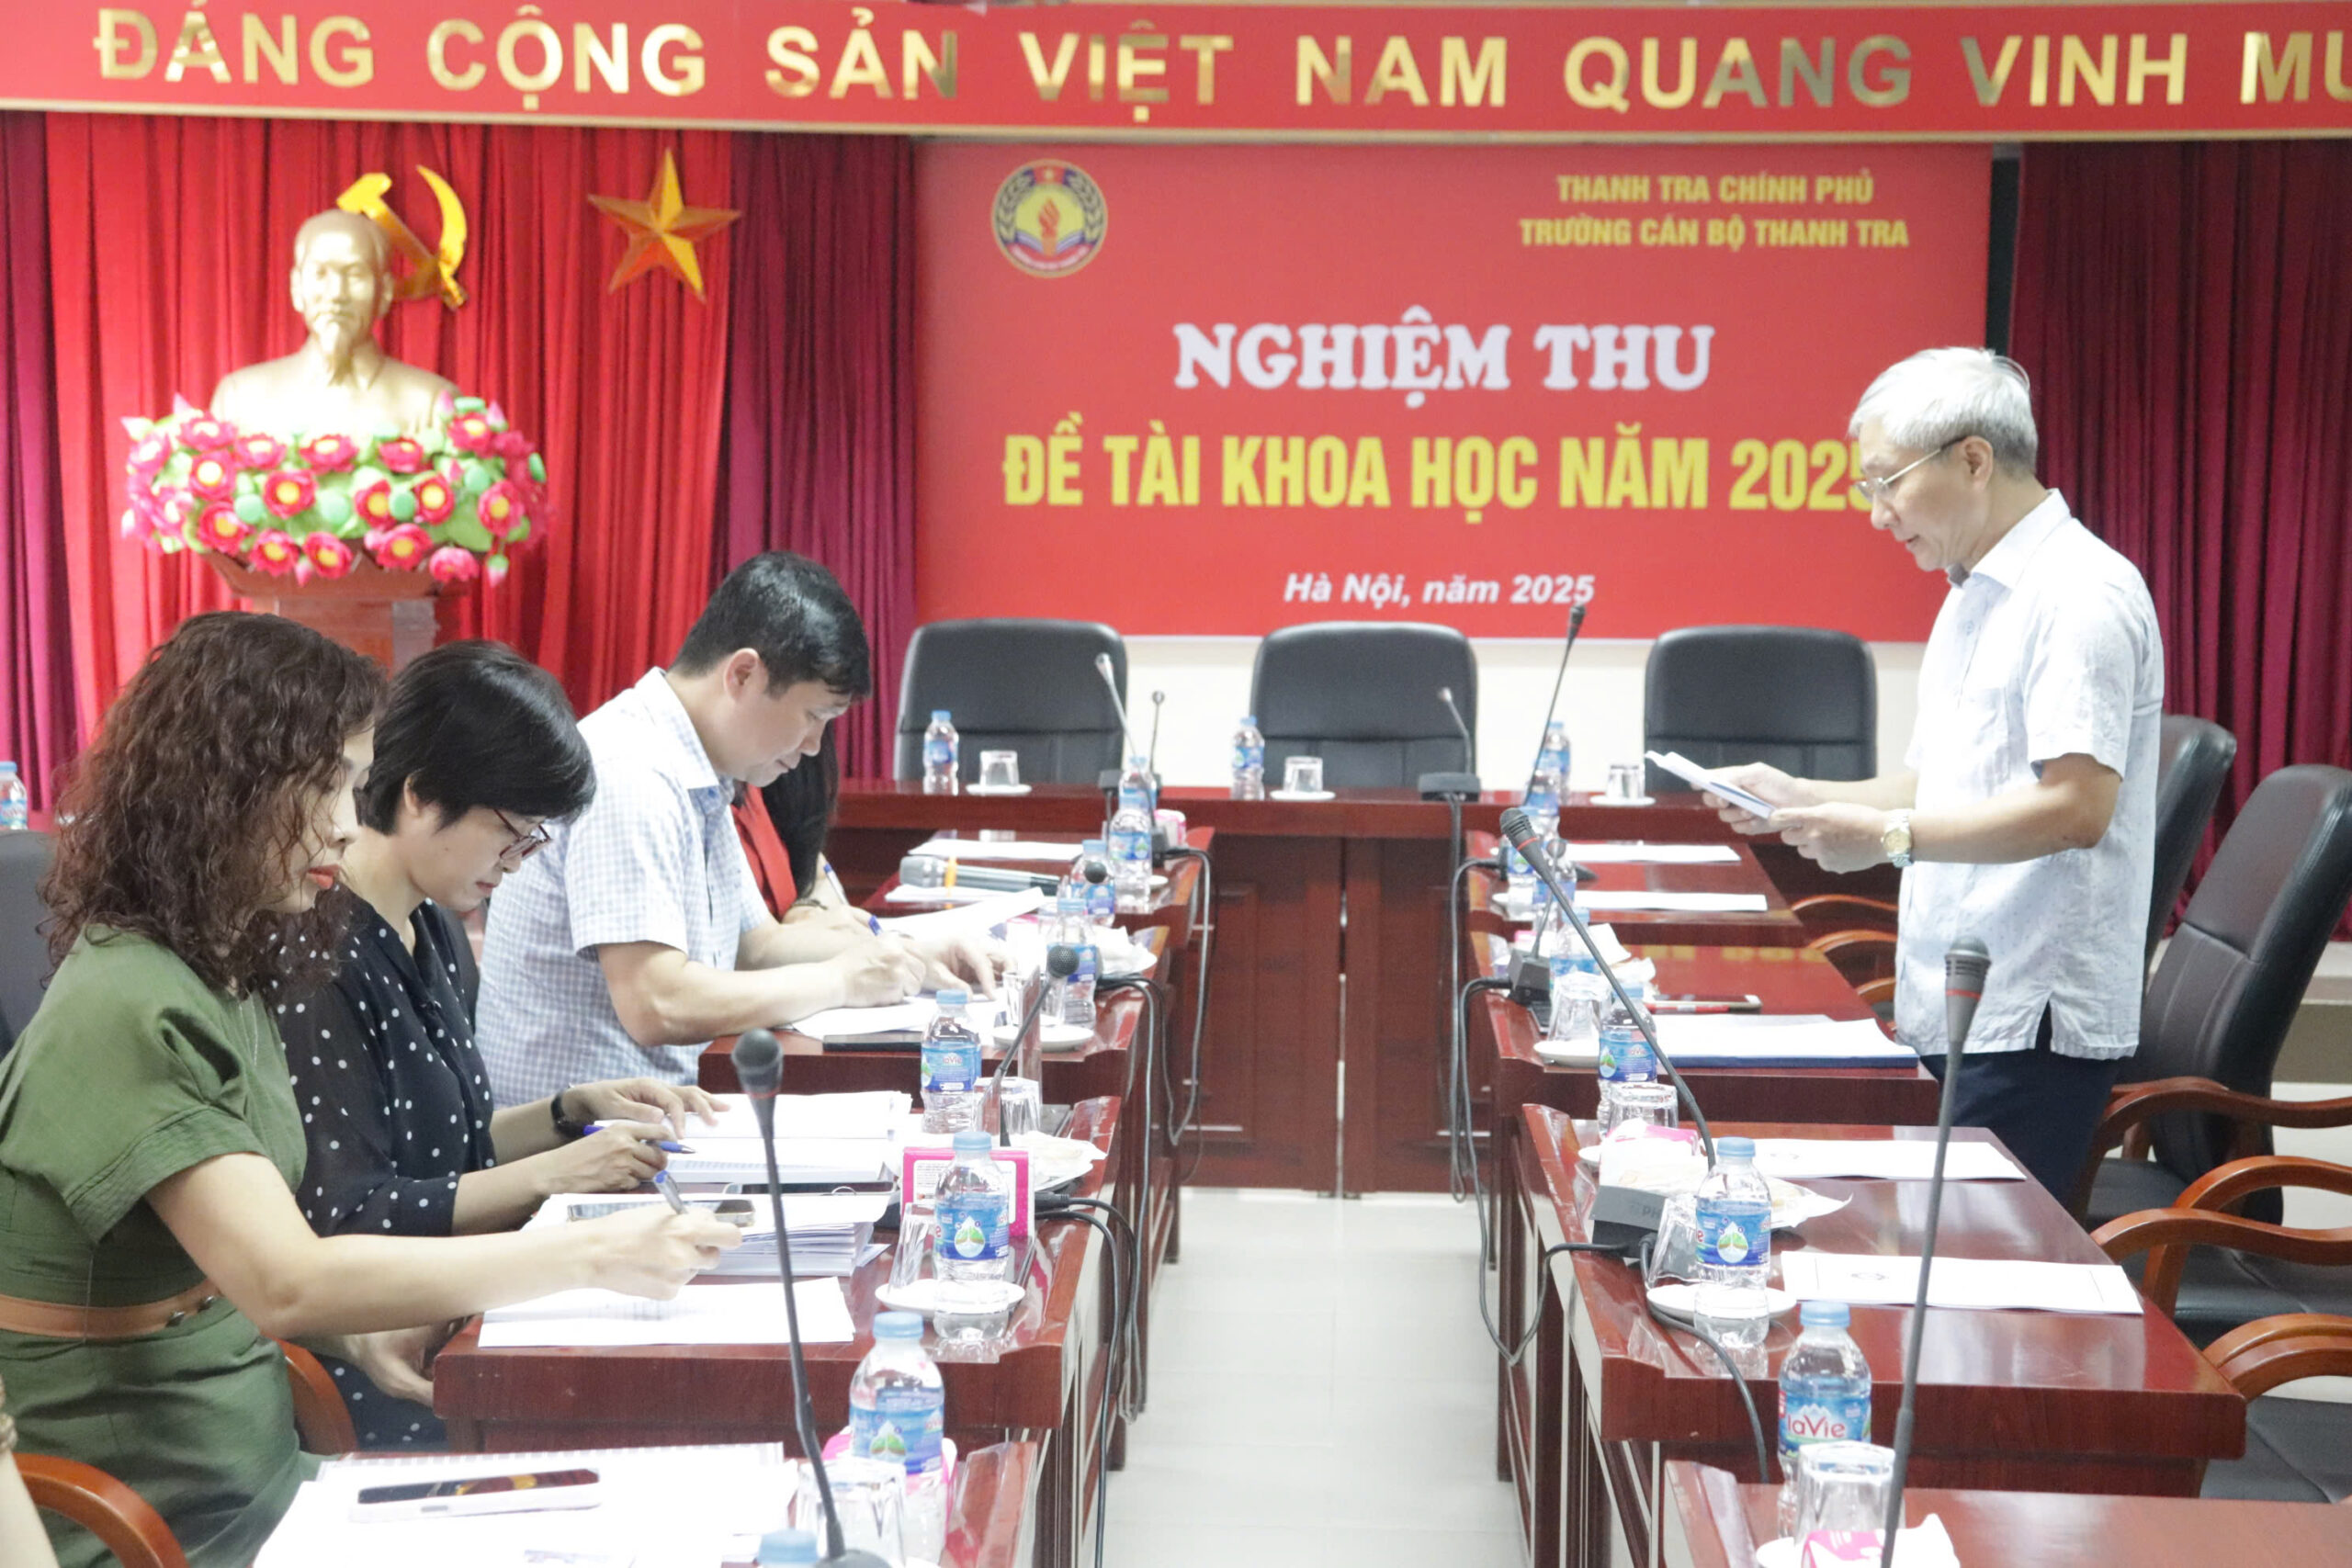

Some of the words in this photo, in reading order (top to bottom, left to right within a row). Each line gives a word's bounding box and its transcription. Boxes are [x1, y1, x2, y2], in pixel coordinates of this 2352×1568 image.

[425, 6, 705, 110] CỘNG
[765, 7, 958, 99] SẢN
[1019, 20, 1233, 122] VIỆT
[1297, 36, 1506, 107] NAM
[1563, 37, 1911, 113] QUANG
[1964, 34, 2187, 106] VINH
[1558, 175, 1649, 201] THANH
[1659, 175, 1710, 202] TRA
[1718, 171, 1807, 203] CHÍNH
[1815, 168, 1874, 203] PHỦ
[1520, 213, 1632, 246] TRƯỜNG
[1707, 215, 1745, 251] BỘ
[1755, 220, 1848, 246] THANH
[1856, 220, 1908, 246] TRA
[1173, 306, 1510, 408] NGHIỆM
[1534, 325, 1714, 390] THU
[1002, 412, 1082, 505] ĐỀ
[1103, 421, 1200, 505] TÀI
[1223, 436, 1390, 507] KHOA
[1411, 436, 1537, 524] HỌC
[1560, 423, 1708, 508] NĂM
[1284, 573, 1331, 602] Hà
[1342, 573, 1409, 609] Nội,
[1423, 575, 1499, 603] năm
[1510, 575, 1595, 604] 2025
[1787, 1414, 1846, 1438] laVie
